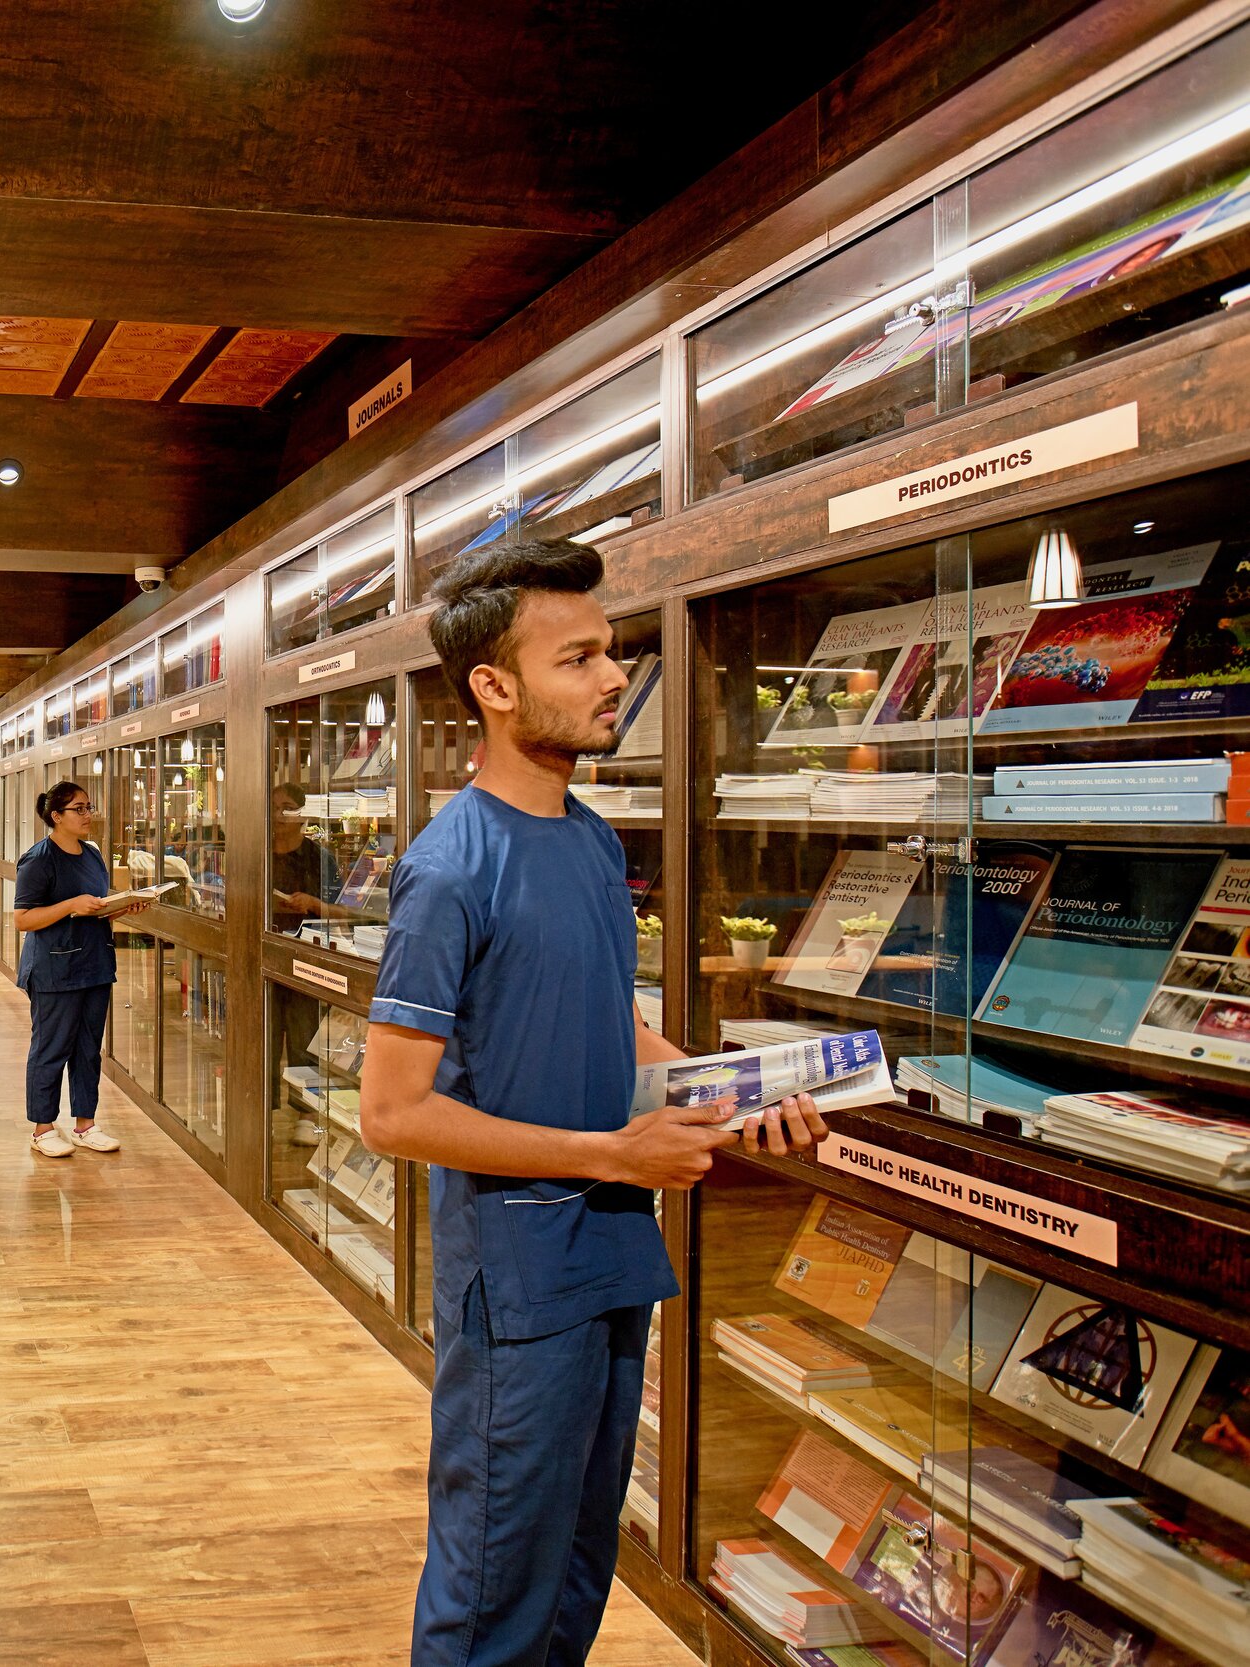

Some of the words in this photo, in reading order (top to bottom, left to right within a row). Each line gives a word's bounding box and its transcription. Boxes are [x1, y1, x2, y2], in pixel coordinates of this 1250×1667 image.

[356, 382, 403, 428] JOURNALS
[898, 449, 1033, 502] PERIODONTICS
[1095, 580, 1146, 593] RESEARCH
[823, 632, 849, 644] ORAL
[852, 622, 906, 640] IMPLANTS
[827, 620, 874, 635] CLINICAL
[819, 637, 871, 652] RESEARCH
[311, 661, 341, 675] ORTHODONTICS
[1190, 690, 1212, 700] EFP
[1098, 714, 1123, 722] WILEY
[834, 868, 901, 883] Periodontics
[904, 874, 914, 884] &
[932, 862, 1040, 883] Periodontology
[1230, 866, 1250, 874] Jour
[827, 880, 889, 894] Restorative
[982, 880, 1022, 895] 2000
[822, 890, 869, 906] Dentistry
[1042, 897, 1098, 912] JOURNAL
[1102, 902, 1121, 912] OF
[1036, 907, 1180, 935] Periodontology
[918, 998, 934, 1007] WILE
[1100, 1028, 1122, 1036] WILEY
[852, 1035, 868, 1048] Color
[830, 1042, 847, 1064] Dental
[855, 1048, 871, 1062] Atlas
[803, 1044, 822, 1085] Endodontology
[839, 1146, 894, 1176] PUBLIC
[898, 1165, 963, 1200] HEALTH
[968, 1188, 1080, 1238] DENTISTRY
[824, 1214, 845, 1228] Indian
[845, 1223, 880, 1243] Association
[881, 1237, 890, 1245] of
[819, 1224, 840, 1238] Public
[840, 1233, 861, 1247] Health
[861, 1241, 890, 1260] Dentistry
[837, 1245, 885, 1274] JIAPHD
[952, 1354, 986, 1376] 47
